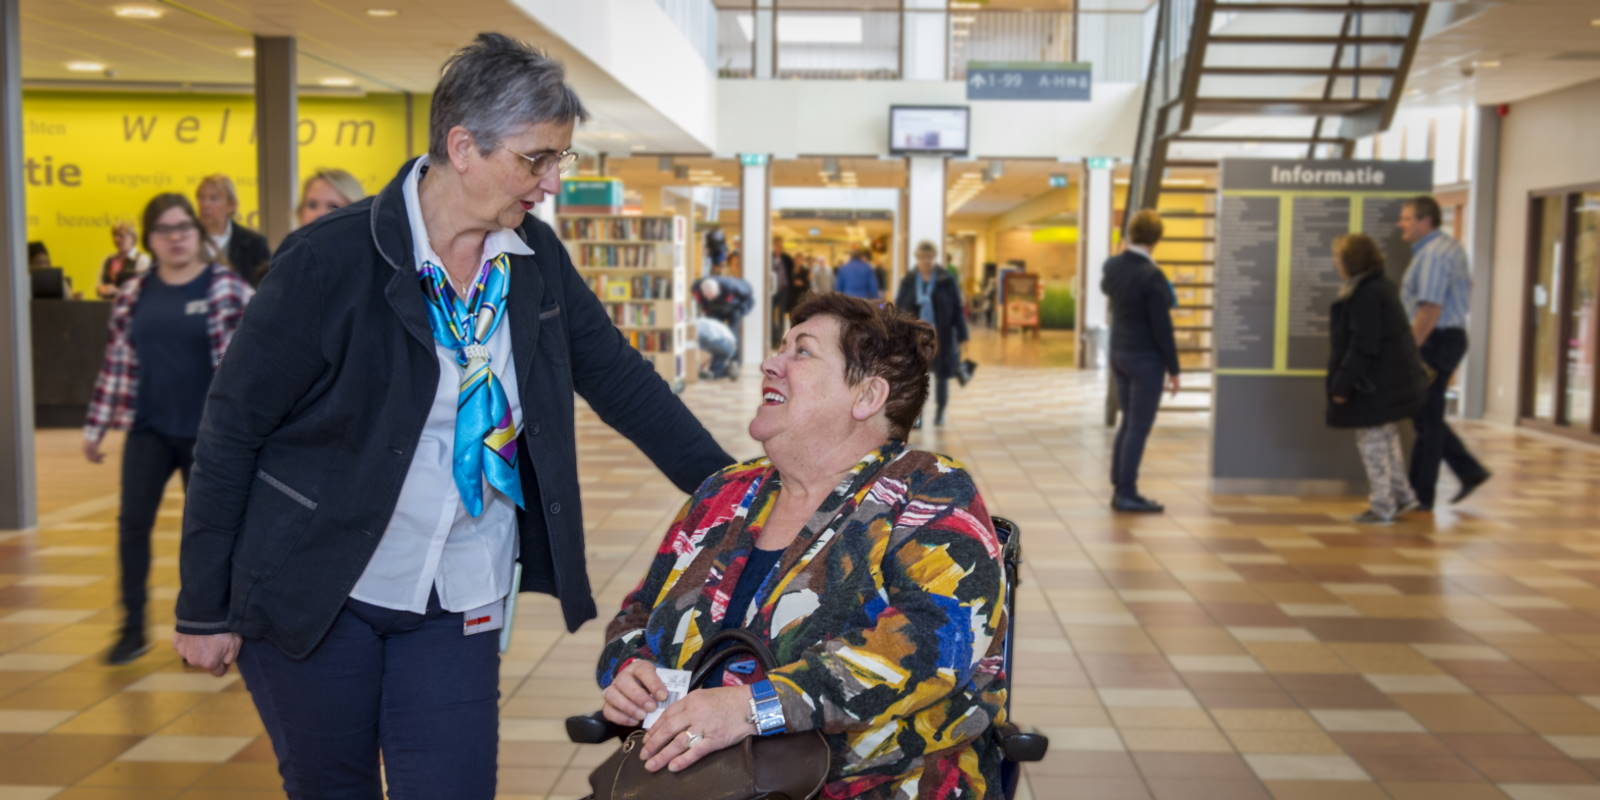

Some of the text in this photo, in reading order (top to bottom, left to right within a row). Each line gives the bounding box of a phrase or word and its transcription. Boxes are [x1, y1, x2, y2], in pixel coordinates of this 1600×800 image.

[988, 73, 1023, 88] 1-99
[122, 108, 376, 147] welom
[1271, 165, 1385, 185] Informatie
